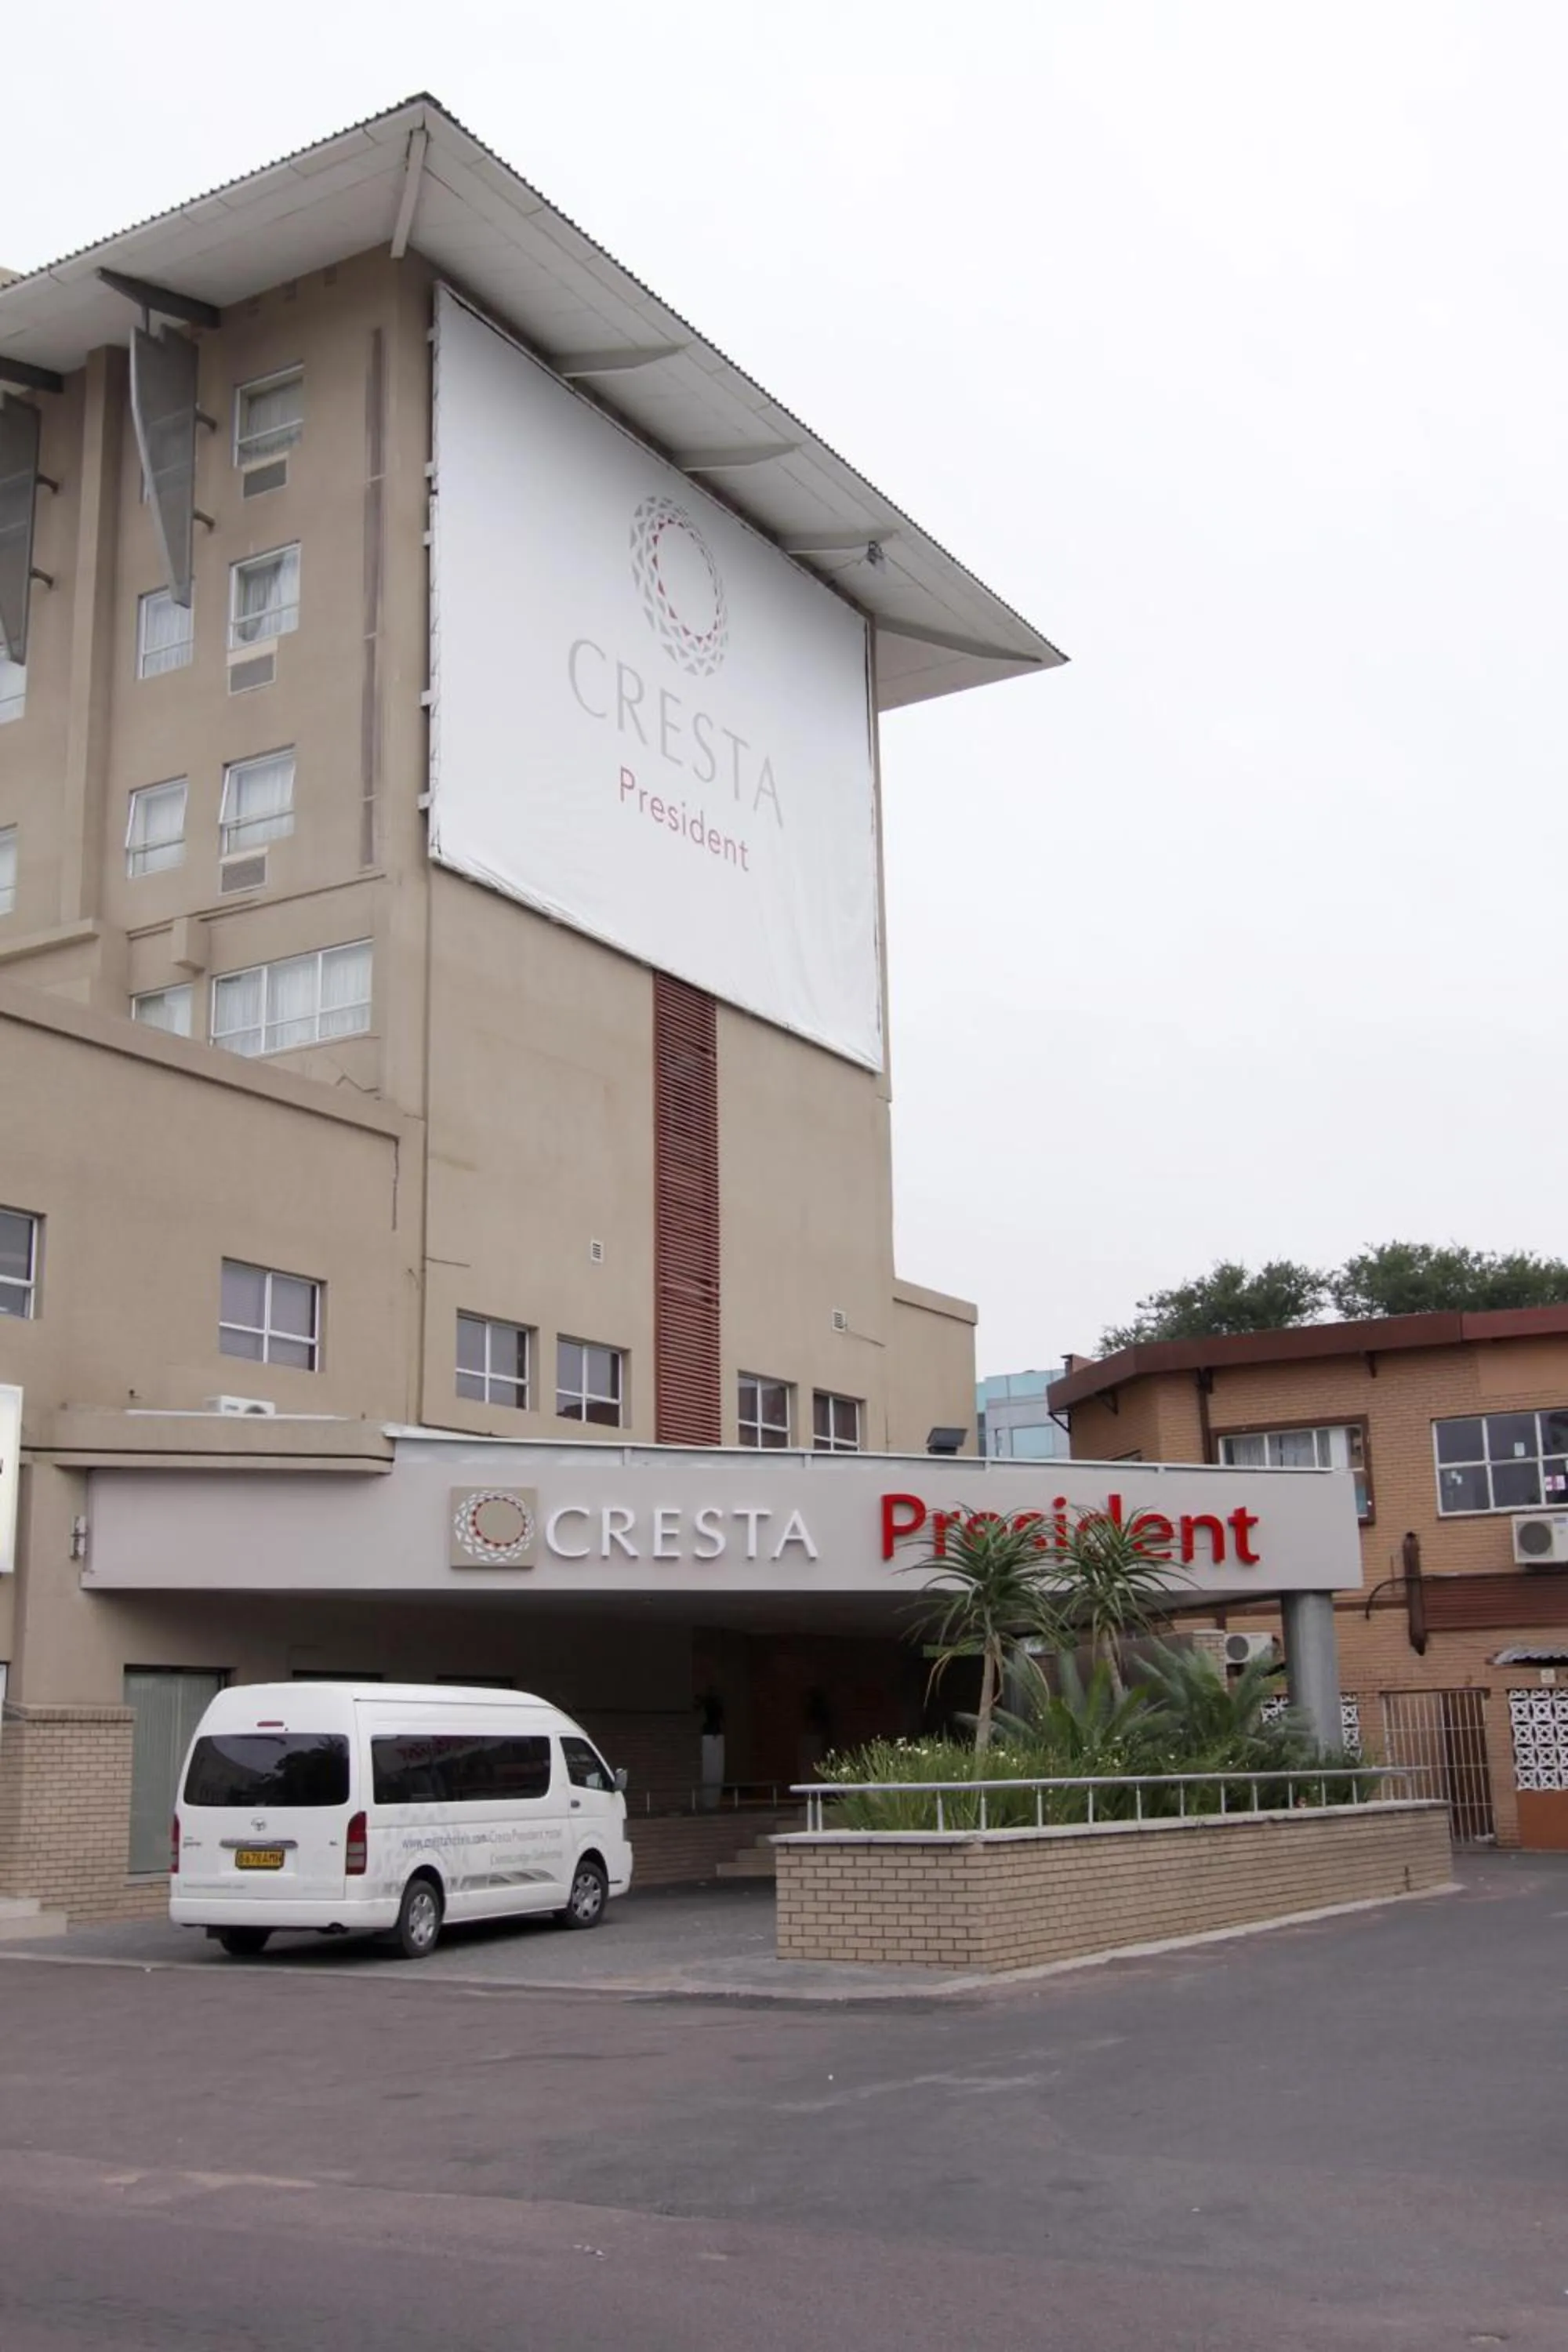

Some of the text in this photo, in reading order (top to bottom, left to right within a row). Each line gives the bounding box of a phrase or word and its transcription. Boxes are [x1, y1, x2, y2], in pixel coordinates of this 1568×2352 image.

[568, 638, 783, 828] CRESTA
[619, 765, 749, 872] President
[546, 1506, 818, 1560] CRESTA
